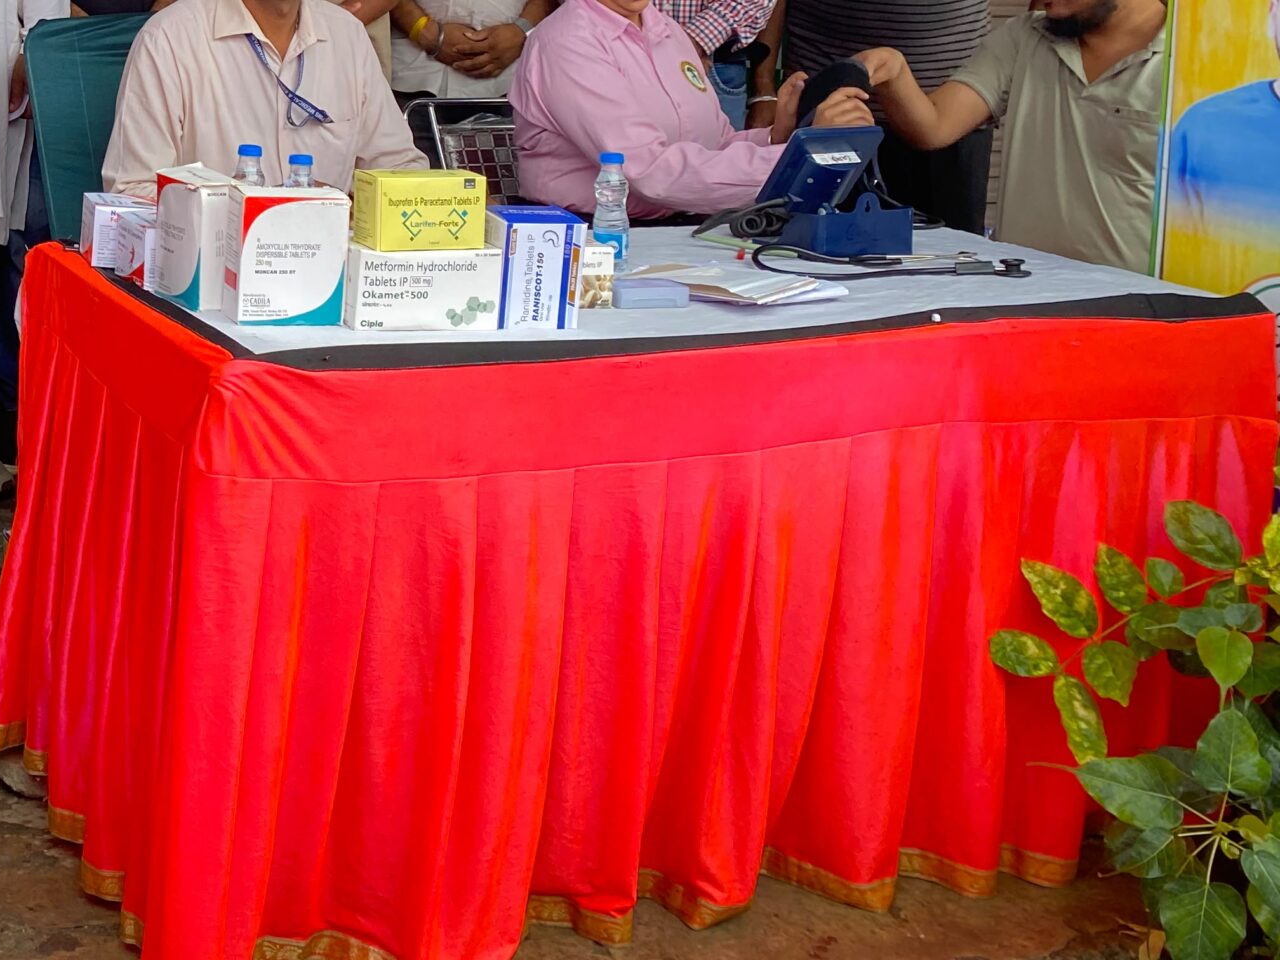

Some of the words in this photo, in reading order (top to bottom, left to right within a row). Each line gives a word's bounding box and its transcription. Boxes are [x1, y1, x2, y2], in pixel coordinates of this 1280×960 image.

[454, 197, 472, 206] Tablets
[364, 260, 414, 272] Metformin
[417, 260, 478, 274] Hydrochloride
[363, 276, 397, 287] Tablets
[399, 276, 409, 287] IP
[411, 277, 421, 285] 500
[422, 279, 432, 287] mg
[532, 252, 545, 321] RANISCOT-150
[360, 320, 384, 328] Cipla
